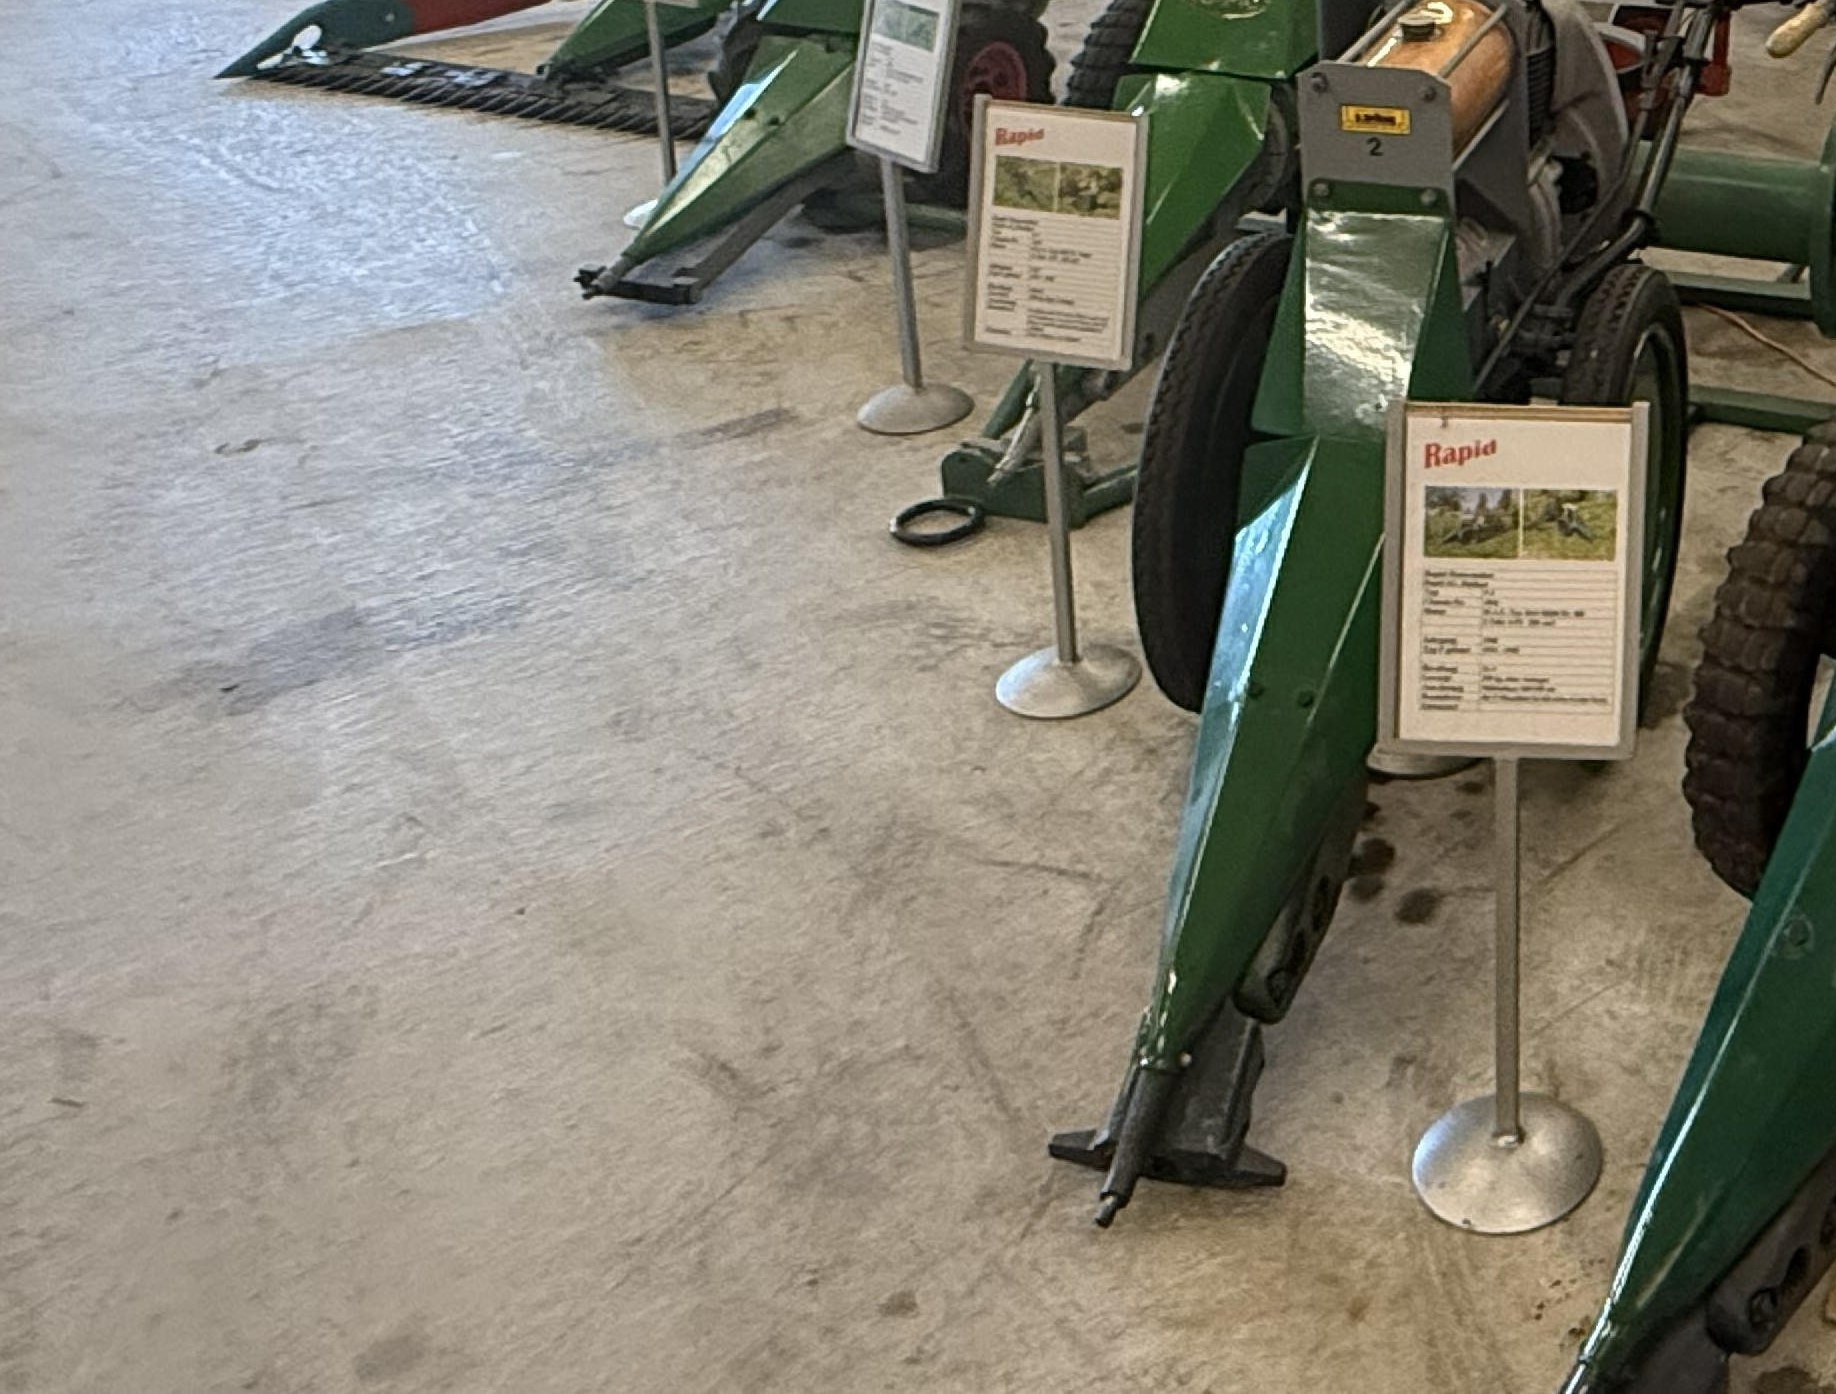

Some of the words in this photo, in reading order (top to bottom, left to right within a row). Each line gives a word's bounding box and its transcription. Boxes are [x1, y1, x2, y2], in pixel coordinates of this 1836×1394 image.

[995, 127, 1045, 146] Rapid
[1366, 137, 1384, 157] 2
[1424, 438, 1497, 468] Rapid
